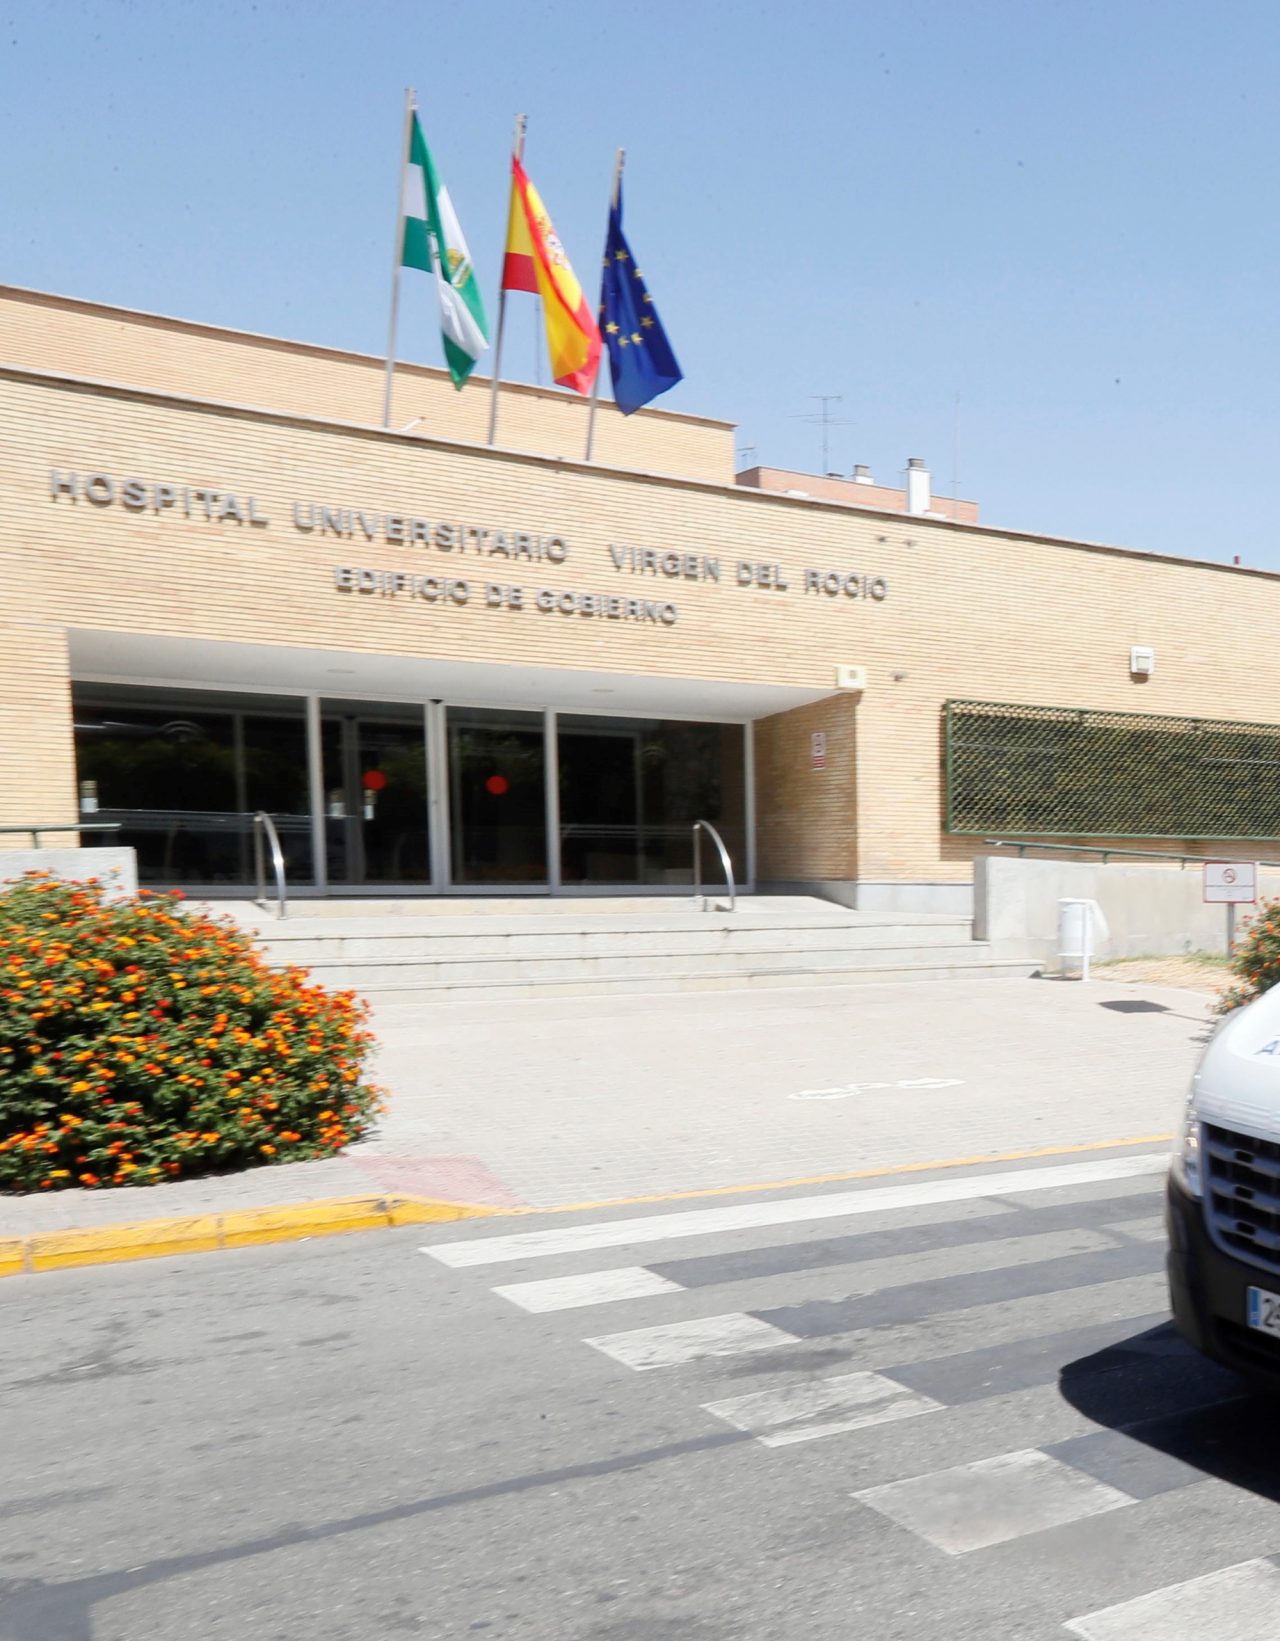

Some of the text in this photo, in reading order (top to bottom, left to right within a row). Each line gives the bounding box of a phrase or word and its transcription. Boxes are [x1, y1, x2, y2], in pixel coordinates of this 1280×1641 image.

[51, 469, 888, 601] HOSPITAL UNIVERSITARIO VIRGEN DEL ROCIO
[335, 564, 678, 625] EDIFICIO DE GOBIERNO
